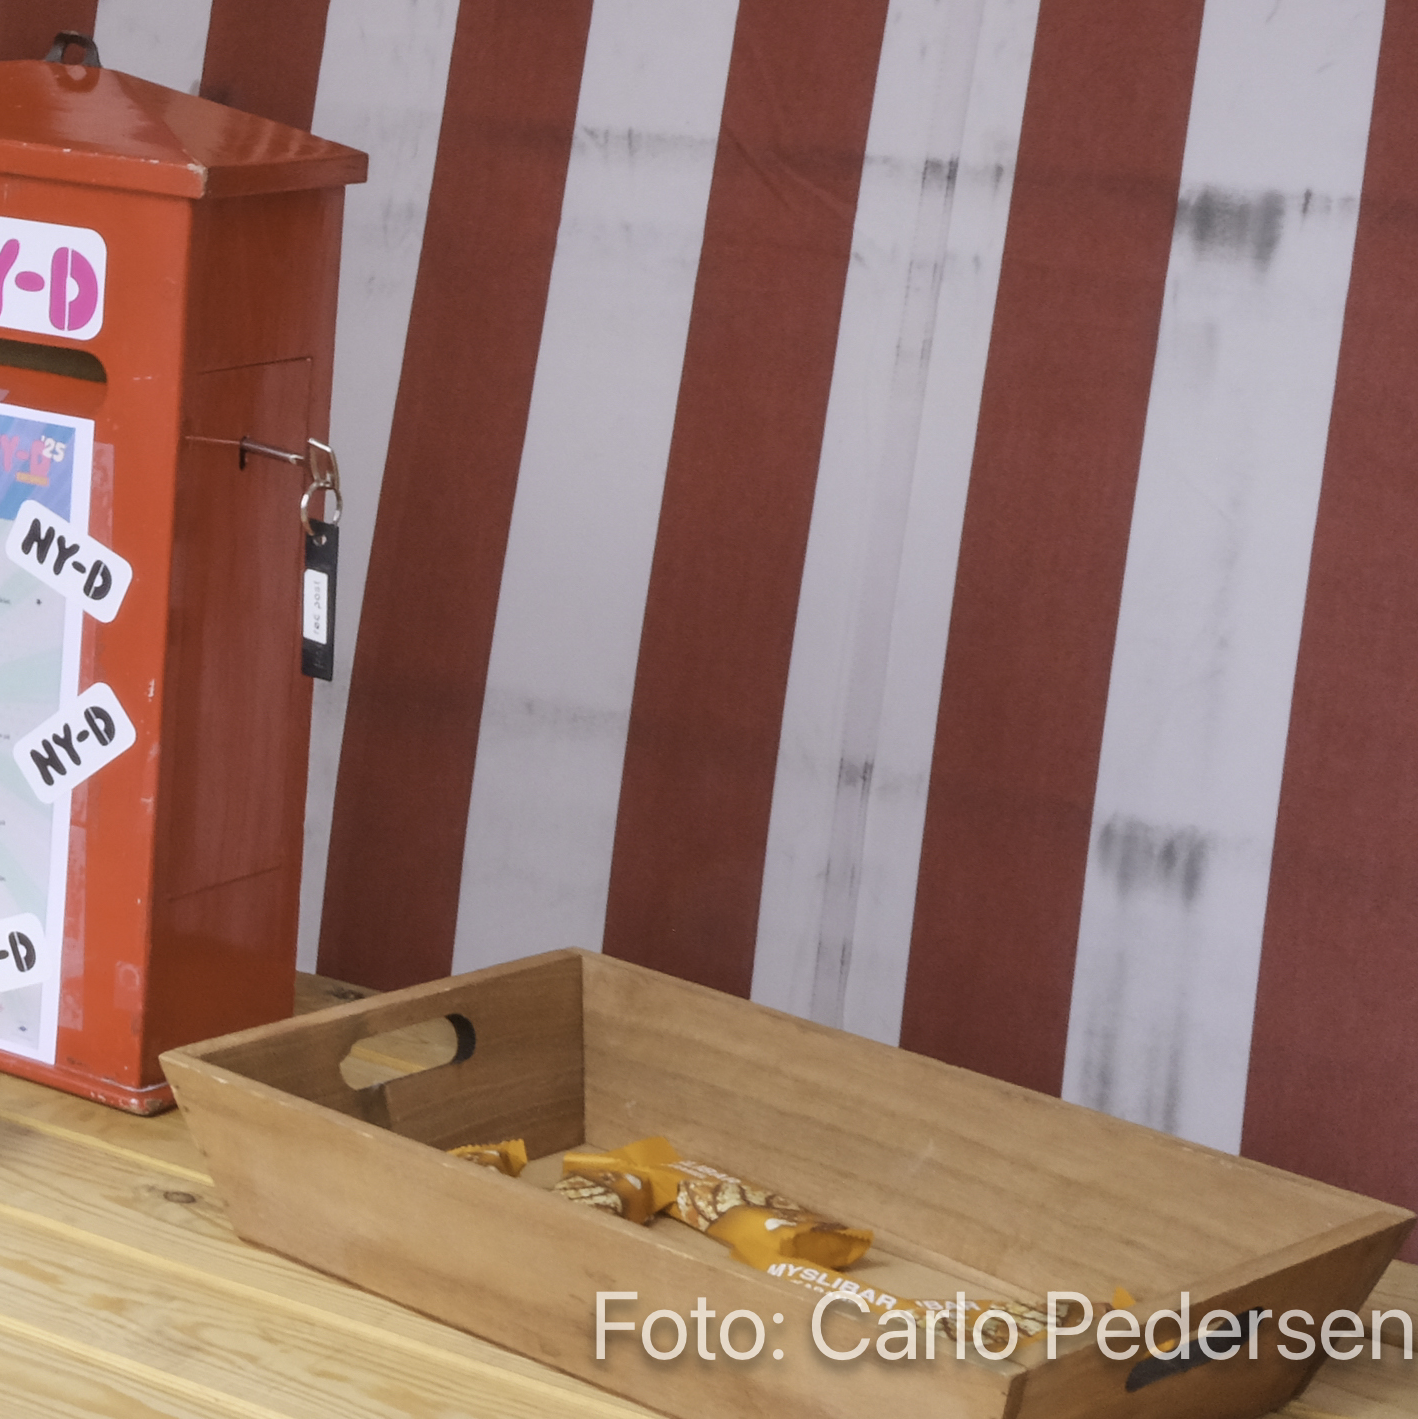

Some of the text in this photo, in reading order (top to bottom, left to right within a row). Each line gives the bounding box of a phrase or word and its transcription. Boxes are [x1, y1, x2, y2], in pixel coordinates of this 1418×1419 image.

[21, 518, 113, 602] NY-D
[30, 705, 116, 786] NY-D
[767, 1262, 897, 1310] MYSLIBAR
